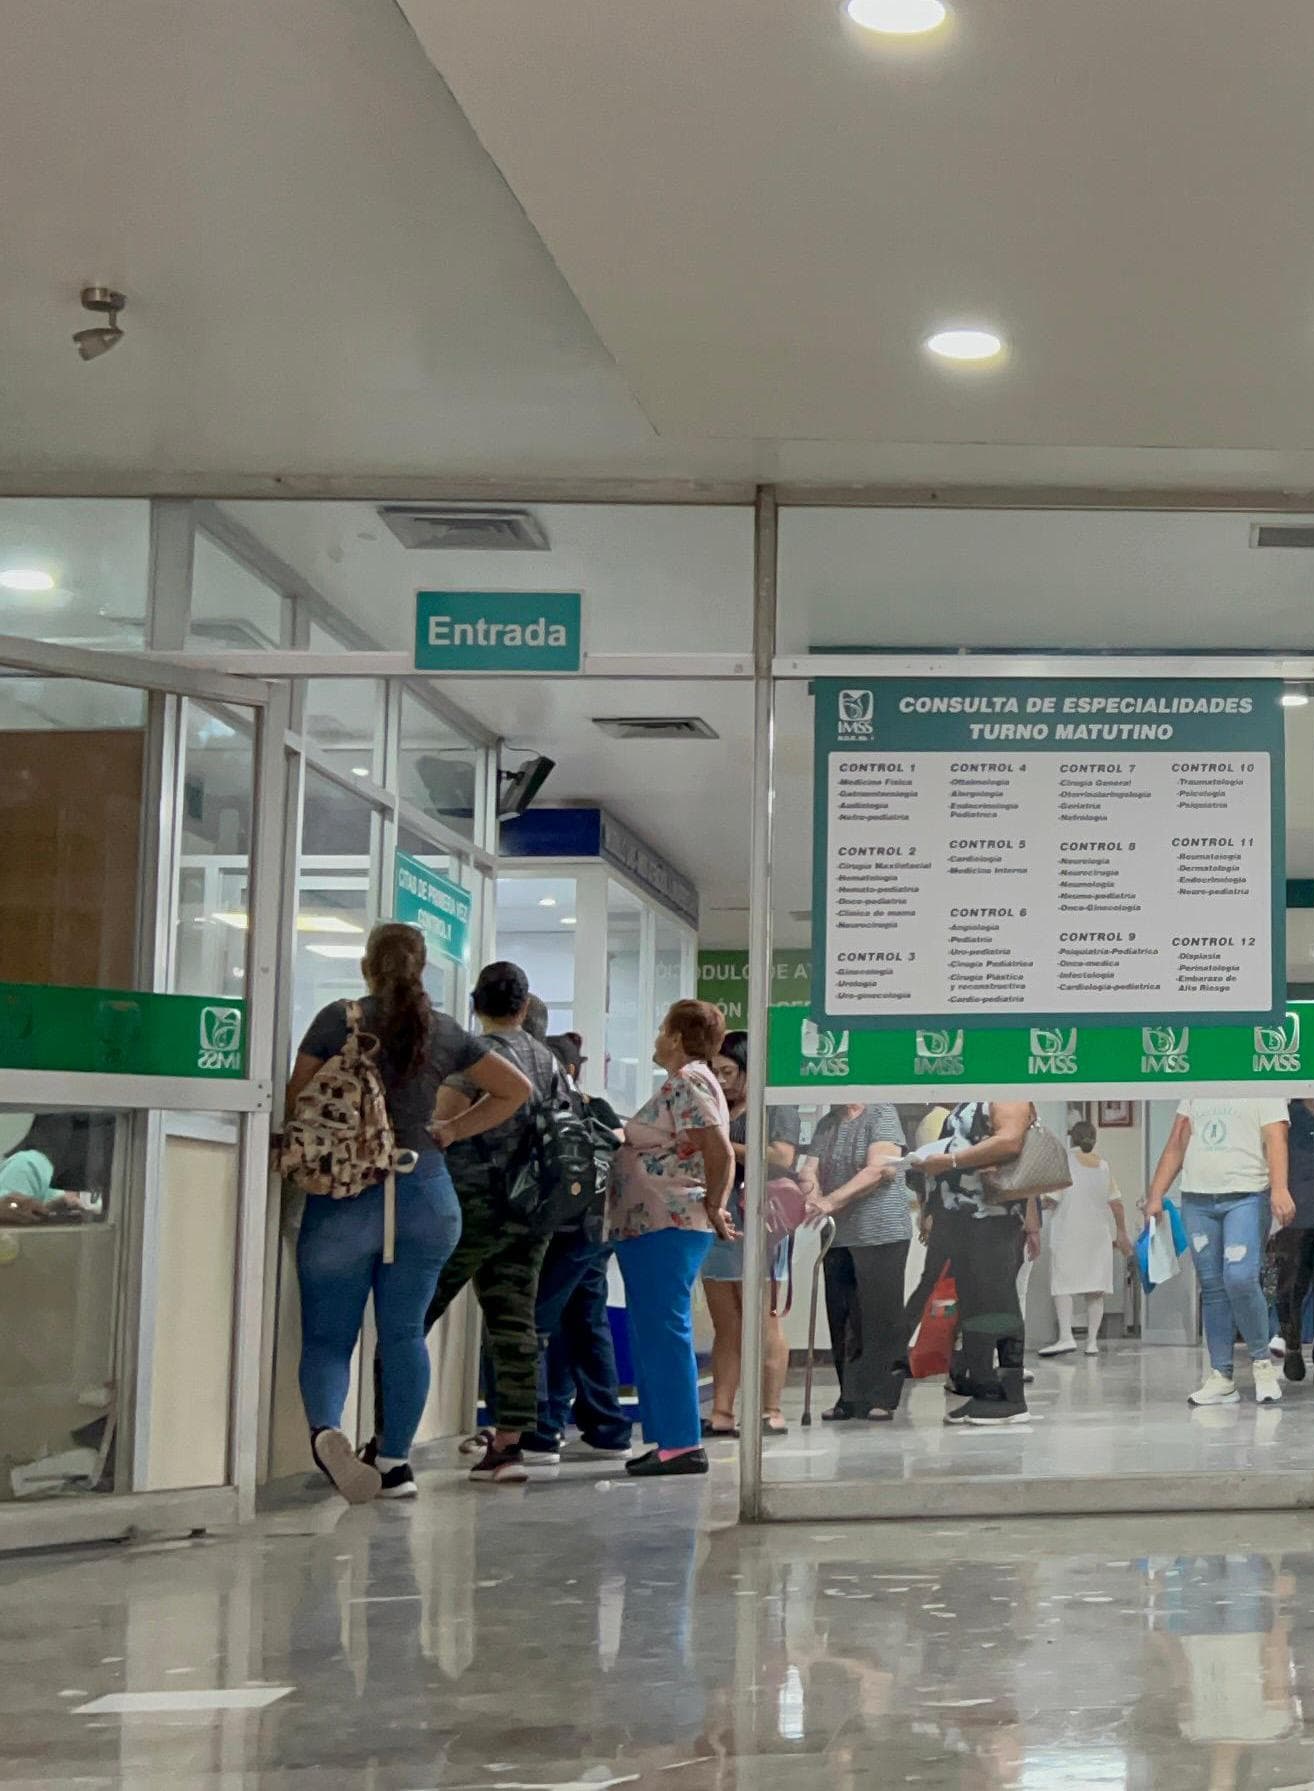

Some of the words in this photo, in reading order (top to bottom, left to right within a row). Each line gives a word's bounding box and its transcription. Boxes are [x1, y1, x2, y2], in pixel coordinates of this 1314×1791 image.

[428, 615, 567, 647] Entrada
[898, 696, 1020, 714] CONSULTA
[1025, 696, 1057, 714] DE
[1062, 696, 1255, 714] ESPECIALIDADES
[838, 720, 874, 735] IMSS
[969, 723, 1050, 740] TURNO
[1054, 723, 1174, 740] MATUTINO
[838, 762, 904, 773] CONTROL
[910, 762, 916, 773] 1
[949, 762, 1014, 773] CONTROL
[1018, 762, 1027, 773] 4
[1059, 763, 1123, 774] CONTROL
[1128, 763, 1137, 774] 7
[1171, 762, 1235, 773] CONTROL
[1240, 762, 1255, 773] 10
[948, 839, 1014, 850] CONTROL
[1018, 839, 1026, 850] 5
[1059, 841, 1123, 852] CONTROL
[1171, 837, 1235, 848] CONTROL
[1240, 837, 1254, 848] 11
[837, 846, 903, 857] CONTROL
[907, 846, 917, 857] 2
[949, 907, 1015, 918] CONTROL
[1018, 907, 1028, 918] 6
[1059, 931, 1124, 943] CONTROL
[1127, 931, 1137, 943] 9
[1171, 936, 1235, 947] CONTROL
[1241, 936, 1256, 947] 12
[837, 951, 903, 963] CONTROL
[907, 951, 917, 963] 3
[913, 1055, 965, 1076] IMSS
[1028, 1055, 1079, 1075] IMSS
[1141, 1055, 1191, 1074] IMSS
[1252, 1054, 1302, 1073] IMSS
